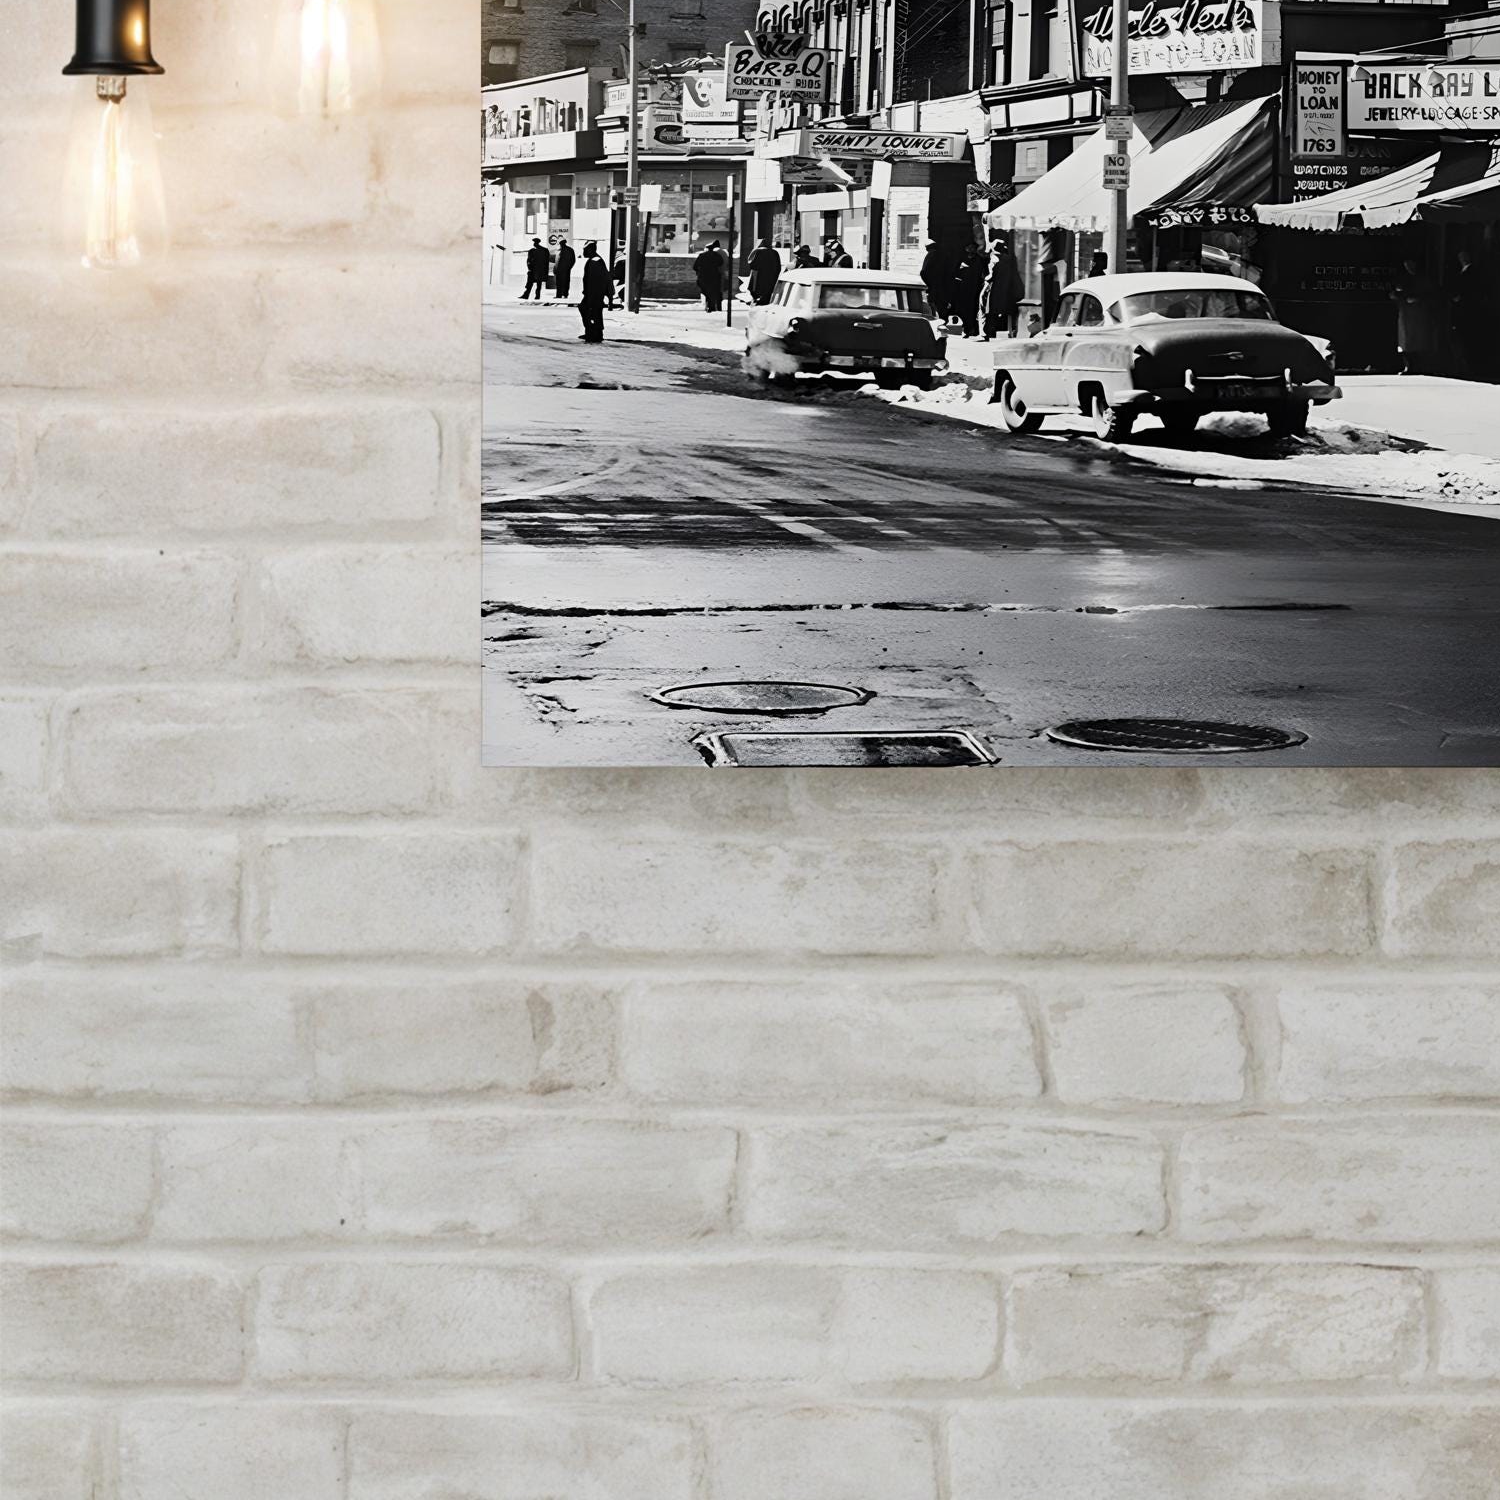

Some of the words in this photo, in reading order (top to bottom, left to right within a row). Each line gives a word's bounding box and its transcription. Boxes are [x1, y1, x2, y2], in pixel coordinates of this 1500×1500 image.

[1299, 71, 1340, 85] MONEY
[1364, 73, 1421, 99] BACK
[1300, 96, 1339, 110] LOAN
[812, 134, 877, 148] SHANTY
[881, 136, 949, 150] LOUNGE
[1303, 138, 1336, 153] 1763
[1108, 156, 1125, 167] NO
